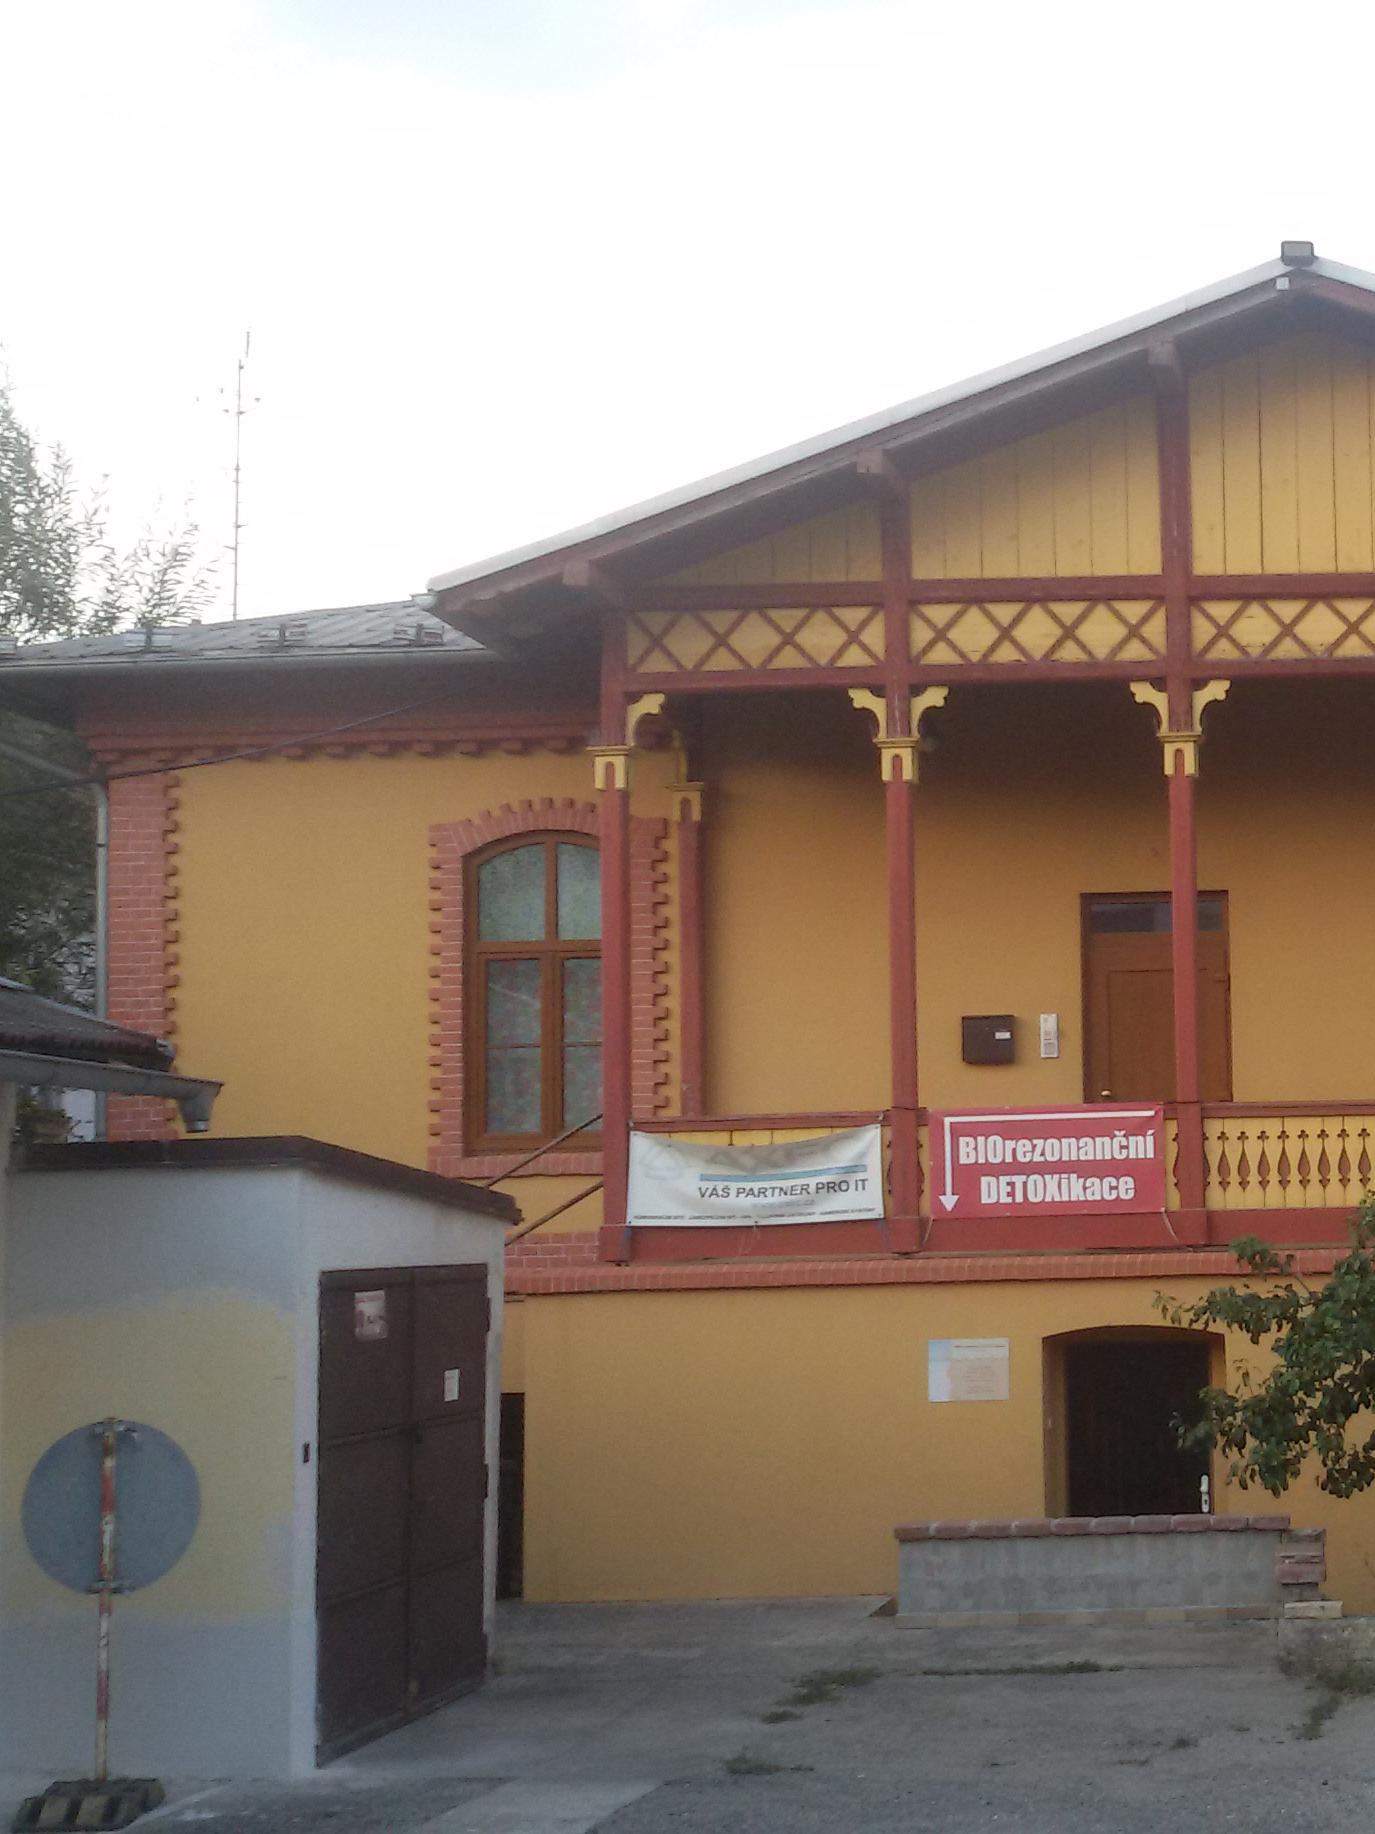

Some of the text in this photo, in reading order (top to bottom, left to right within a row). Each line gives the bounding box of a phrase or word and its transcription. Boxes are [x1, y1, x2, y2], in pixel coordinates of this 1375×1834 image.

[958, 1129, 1155, 1164] BIOrezonanční
[698, 1178, 869, 1198] VÁŠ PARTNER PRO IT
[980, 1173, 1136, 1204] DETOXikace
